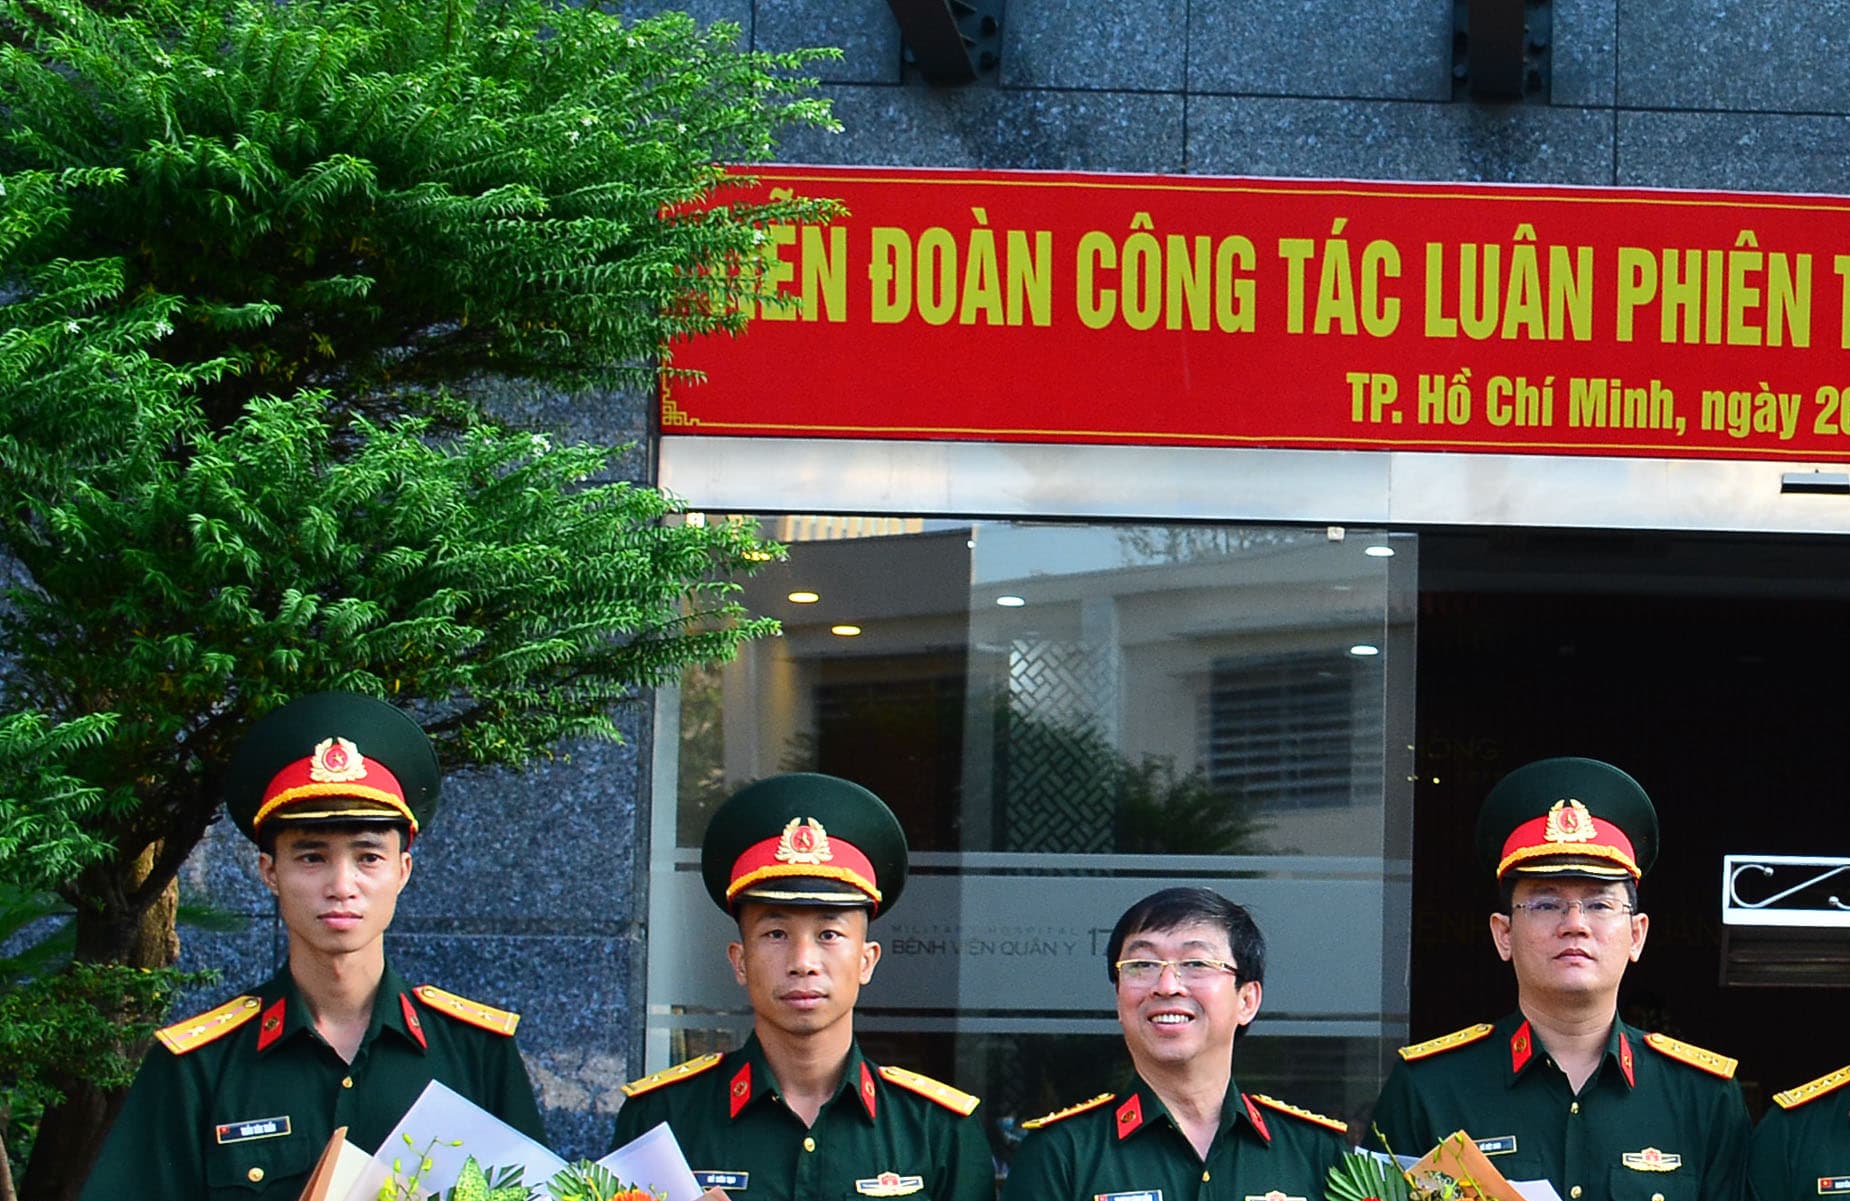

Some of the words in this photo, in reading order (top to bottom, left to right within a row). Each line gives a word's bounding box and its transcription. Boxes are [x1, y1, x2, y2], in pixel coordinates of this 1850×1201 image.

[703, 187, 847, 323] IỄN
[868, 207, 1051, 326] ĐOÀN
[1076, 212, 1257, 333] CÔNG
[1279, 217, 1402, 337] TÁC
[1425, 223, 1594, 341] LUÂN
[1617, 230, 1812, 348] PHIÊN
[1346, 372, 1403, 424] TP.
[1419, 368, 1472, 425] Hồ
[1486, 374, 1557, 427] Chí
[1570, 378, 1686, 433] Minh,
[1702, 380, 1803, 440] ngày
[949, 936, 995, 957] VỆN
[999, 936, 1057, 957] QUÂN
[1063, 940, 1077, 956] Y
